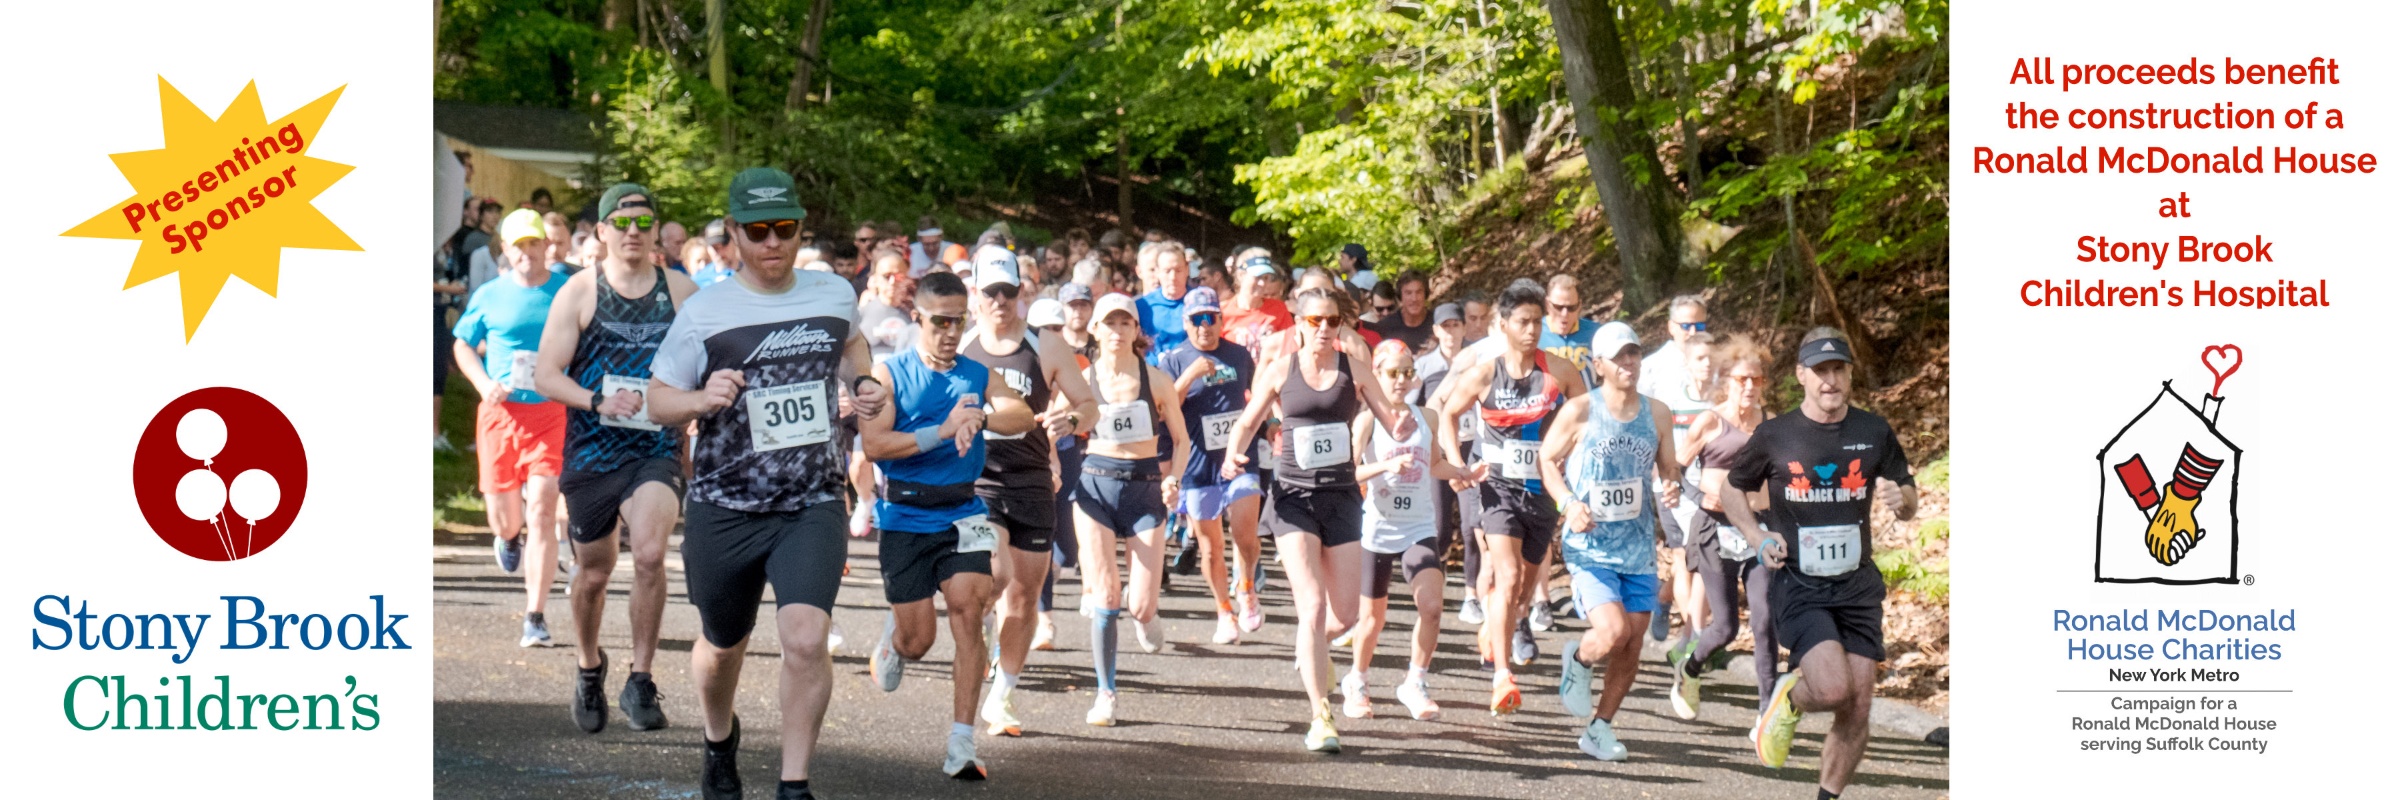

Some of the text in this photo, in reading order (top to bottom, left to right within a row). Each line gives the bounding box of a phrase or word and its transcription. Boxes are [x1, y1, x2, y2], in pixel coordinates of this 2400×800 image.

[757, 344, 832, 361] RUNNERS
[764, 396, 815, 427] 305
[1113, 417, 1132, 431] 64
[1314, 439, 1332, 454] 63
[1592, 436, 1653, 465] BROOKLYN
[1513, 449, 1539, 465] 30
[1601, 488, 1634, 507] 309
[1785, 486, 1834, 502] FALLBACK
[1393, 496, 1411, 510] 99
[1817, 542, 1846, 560] 111
